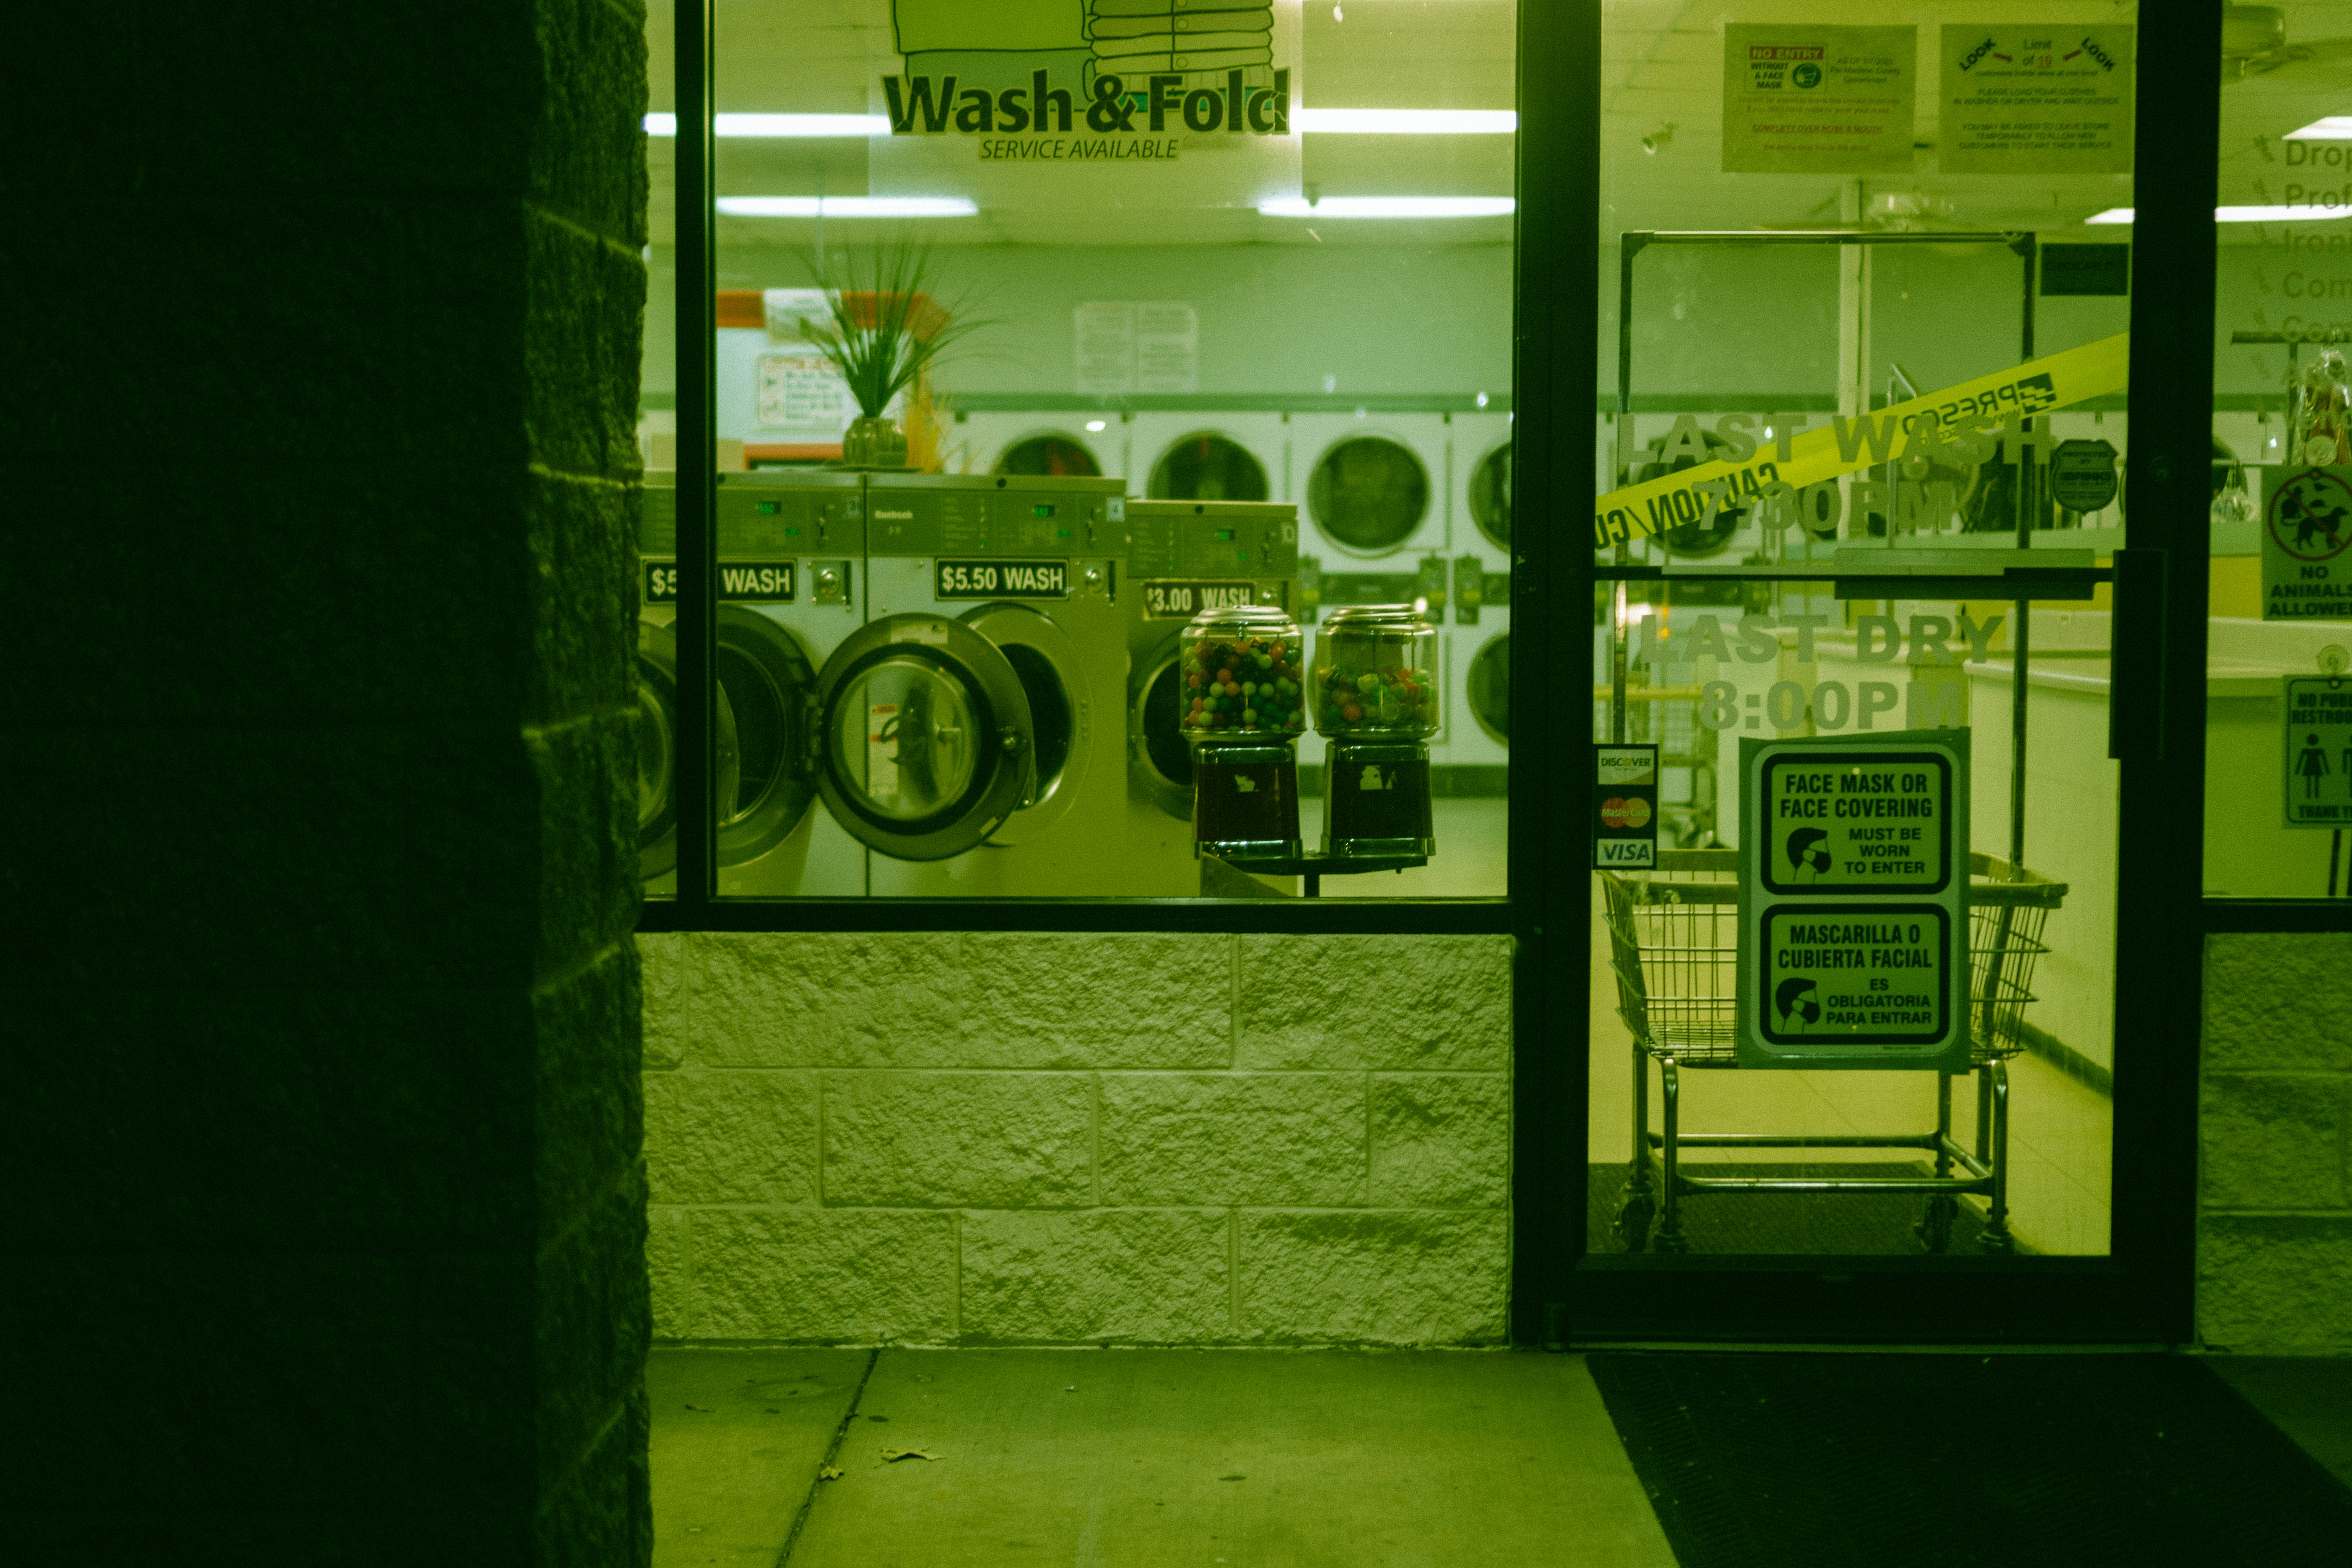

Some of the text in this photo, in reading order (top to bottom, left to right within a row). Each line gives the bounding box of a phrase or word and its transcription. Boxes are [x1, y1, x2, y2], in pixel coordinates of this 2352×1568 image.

[2023, 39, 2052, 50] Limit
[1752, 47, 1820, 60] NO ENTRY
[1959, 39, 1996, 71] LOOK
[2080, 37, 2117, 72] LOOK
[1750, 62, 1789, 70] WITHOUT
[1763, 71, 1784, 80] FACE
[881, 69, 1073, 132] Wash
[1149, 67, 1290, 133] Fold
[981, 140, 1178, 159] SERVICE AVAILABLE
[1618, 414, 1807, 465] LAST
[1833, 414, 2052, 465] WASH
[1692, 481, 1959, 532] 7:30PM
[723, 568, 790, 593] WASH
[942, 566, 1063, 591] $5.50 WASH
[2300, 566, 2329, 579] NO
[1147, 587, 1250, 612] $3.00 WASH
[2270, 602, 2352, 615] ALLOWE
[1640, 614, 2006, 664] LAST DRY
[1700, 680, 1961, 731] 8:00PM
[2298, 693, 2316, 707] NO
[1601, 758, 1651, 767] DISCOVER
[1786, 774, 1927, 794] FACE MASK OR
[1780, 798, 1933, 818] FACE COVERING
[1849, 828, 1921, 840] MUST BE
[1602, 844, 1651, 860] VISA
[1859, 845, 1911, 857] WORN
[1844, 862, 1925, 874] TO ENTER
[1790, 924, 1920, 944] MASCARILLA O
[1778, 949, 1932, 969] CUBIERTA FACIAL
[1870, 978, 1889, 991] ES
[1827, 995, 1931, 1008] OBLIGATORIA
[1826, 1012, 1931, 1024] PARA ENTRAR
